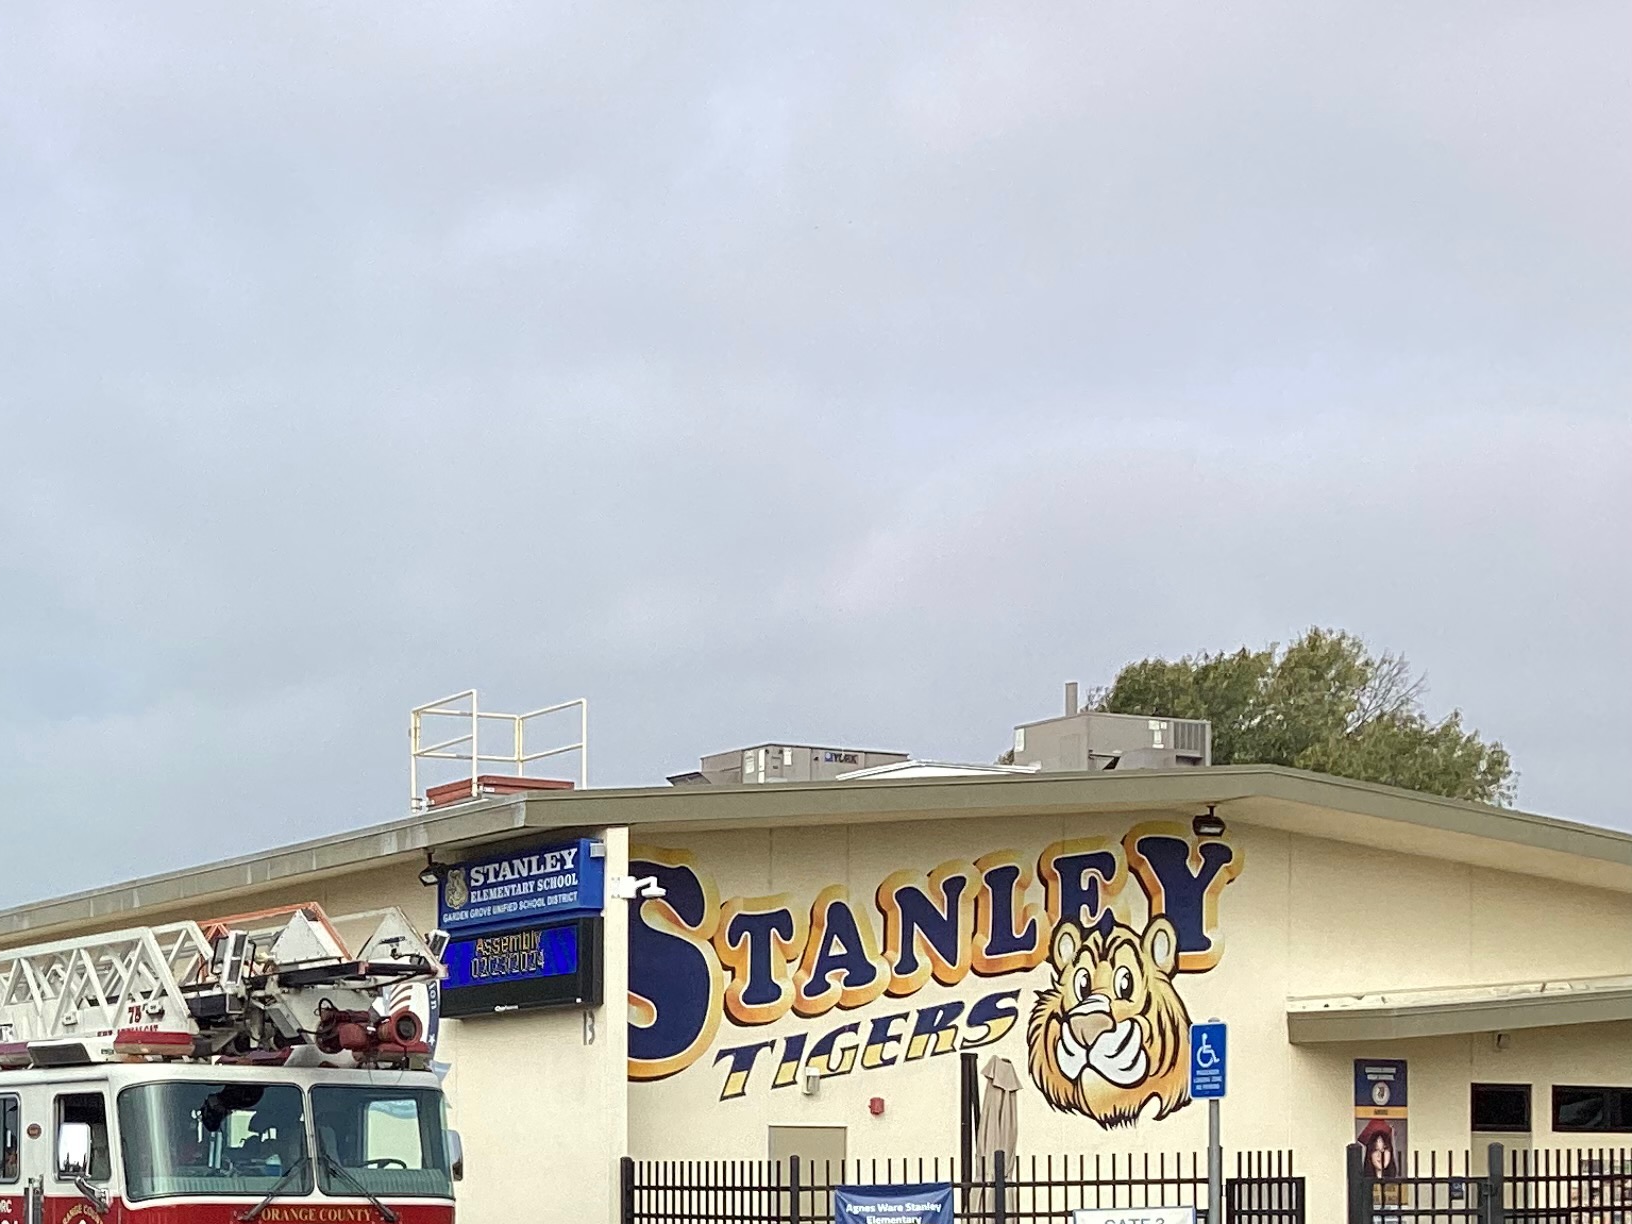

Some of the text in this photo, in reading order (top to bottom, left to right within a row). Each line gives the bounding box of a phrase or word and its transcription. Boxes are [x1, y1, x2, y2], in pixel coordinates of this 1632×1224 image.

[470, 848, 577, 887] STANLEY
[470, 873, 578, 903] ELEMENTARY SCHOOL
[443, 891, 578, 923] GARDEN GROVE UNIFIED SCHOOL DISTRICT
[476, 930, 542, 957] Assembly
[627, 822, 1244, 1081] STANLEY
[713, 988, 1022, 1102] TIGERS
[261, 1208, 372, 1222] ORANGE COUNTY
[846, 1202, 942, 1215] Agnes Ware Stanley
[866, 1216, 922, 1224] Elementary
